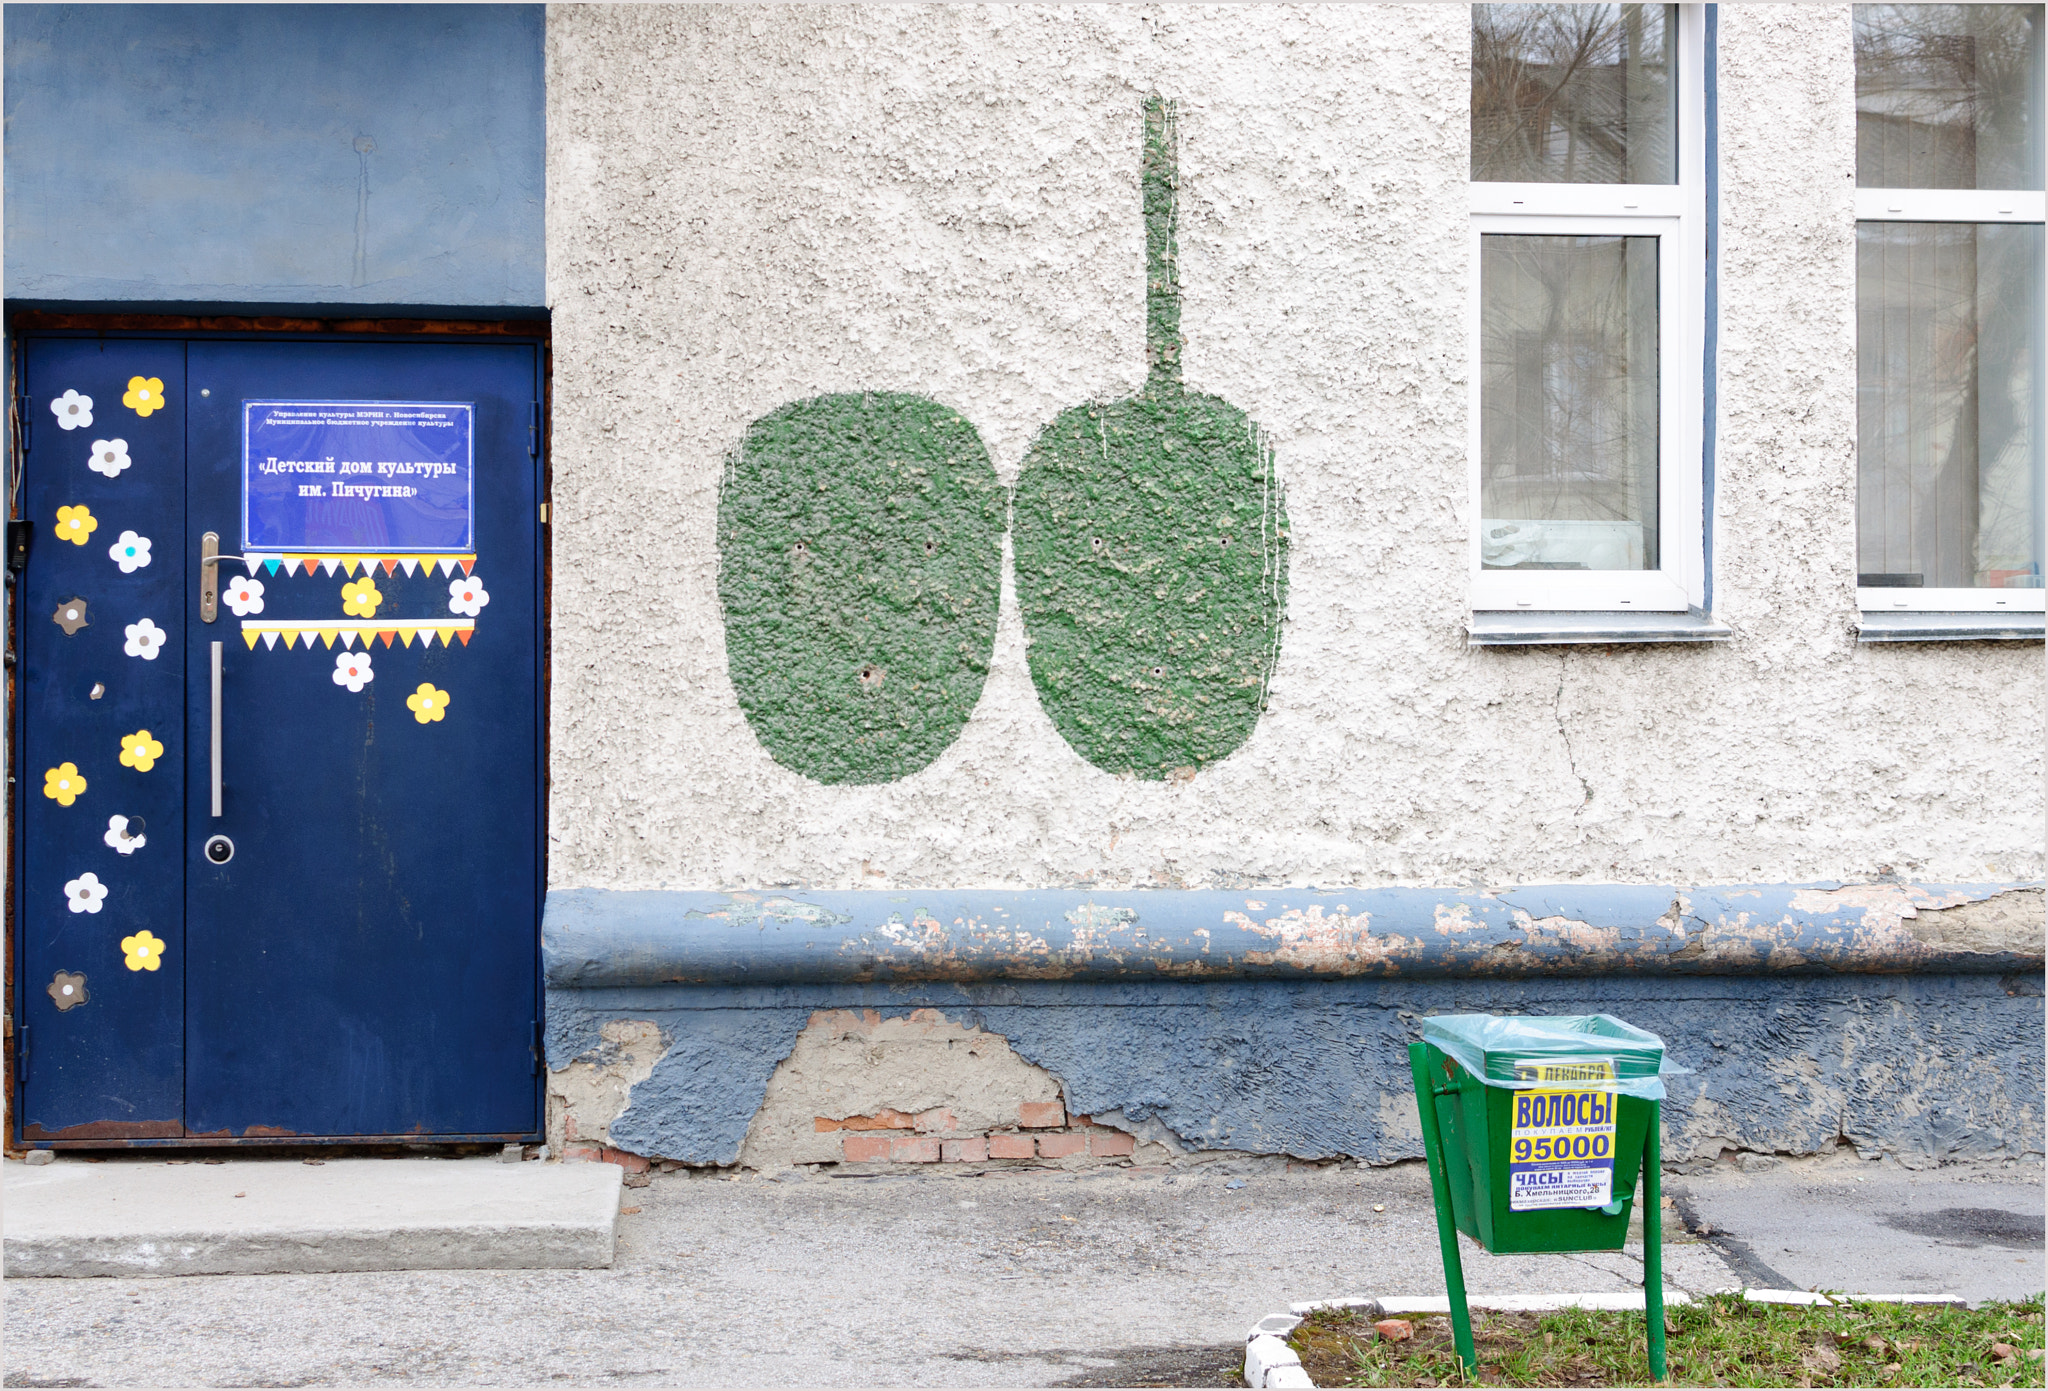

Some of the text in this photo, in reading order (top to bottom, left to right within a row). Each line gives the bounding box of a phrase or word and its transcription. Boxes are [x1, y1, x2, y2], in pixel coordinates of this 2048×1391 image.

[273, 410, 317, 418] Управление
[319, 411, 355, 420] культуры
[394, 412, 446, 420] Новосибирска
[259, 457, 457, 479] «Детский дом культуры
[298, 482, 418, 501] им. Пичугина»
[1516, 1092, 1613, 1128] ВОЛОСЫ
[1515, 1127, 1583, 1136] ПОКУПАЕМ
[1514, 1134, 1610, 1161] 95000
[1516, 1172, 1563, 1186] ЧАСЫ
[1515, 1190, 1524, 1198] Б.
